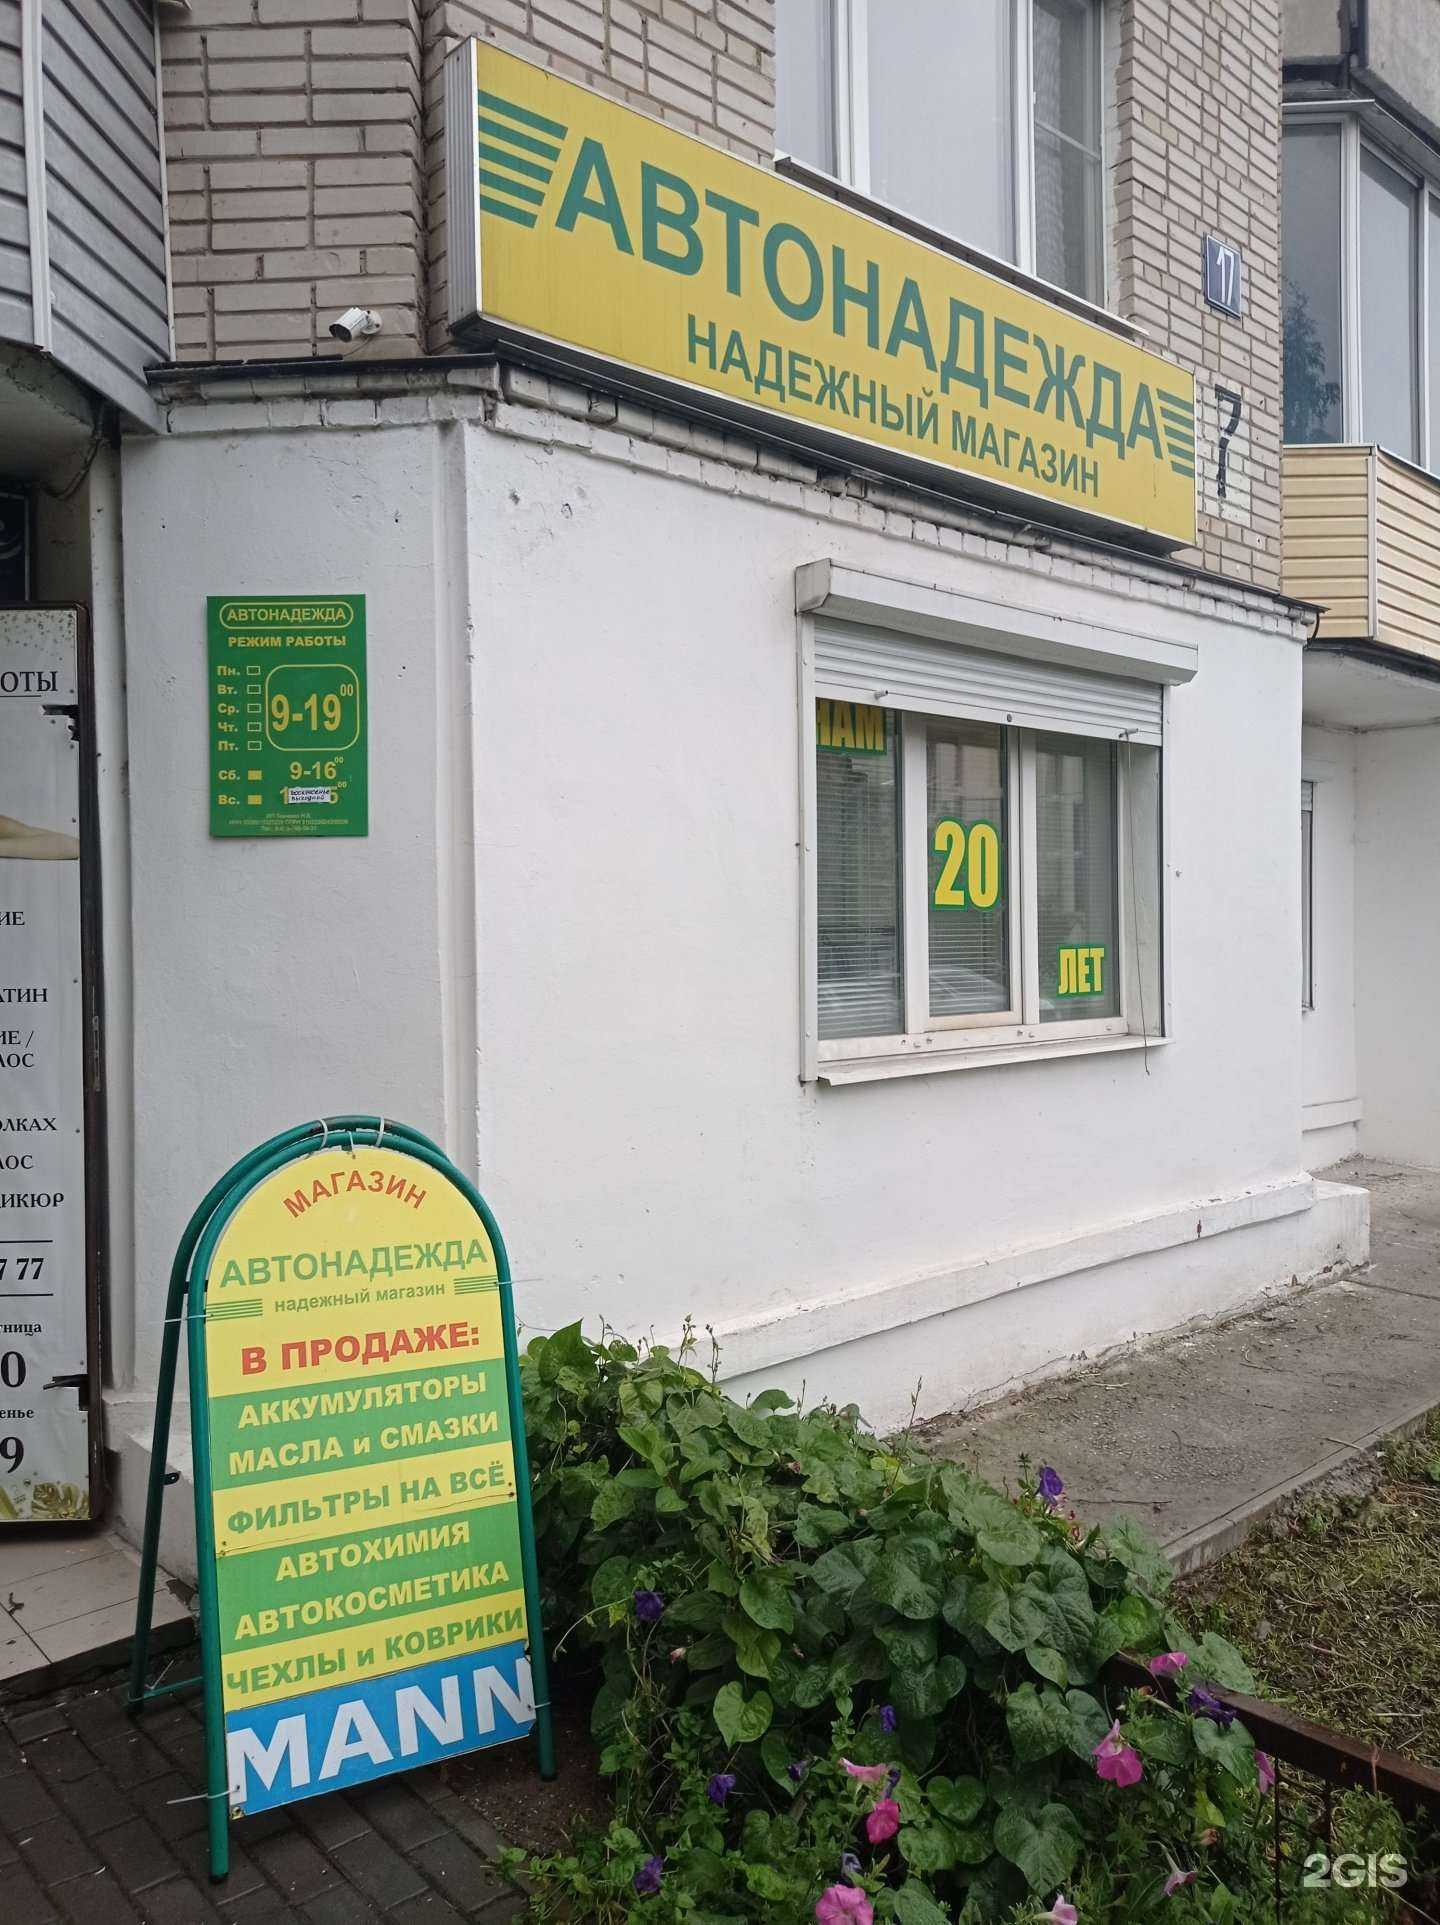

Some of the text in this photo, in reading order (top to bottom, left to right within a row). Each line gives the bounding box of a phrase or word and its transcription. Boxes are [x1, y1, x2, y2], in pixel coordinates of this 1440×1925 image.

[1216, 245, 1235, 306] 17
[556, 137, 1163, 461] АВТОНАДЕЖДА
[687, 314, 1099, 498] НАДЕЖНЫЙ МАГАЗИН
[227, 607, 346, 623] АВТОНАДЕЖДА
[228, 635, 346, 648] РЕЖИМ РАБОТЫ
[217, 665, 240, 677] Пн.
[217, 685, 237, 695] Вт.
[217, 703, 240, 716] Ср.
[217, 722, 238, 733] Чт.
[218, 741, 239, 751] Пт.
[218, 770, 240, 781] Сб.
[218, 795, 240, 805] Вс.
[933, 819, 1001, 909] 20
[1058, 946, 1105, 995] ЛЕТ
[0, 988, 48, 1002] ТИН
[0, 1117, 57, 1131] ЛКАХ
[0, 1193, 64, 1208] ИКЮР
[283, 1170, 427, 1218] МАГАЗИН
[16, 1258, 44, 1280] 77
[219, 1239, 488, 1288] АВТОНАДЕЖДА
[275, 1284, 445, 1313] надежный магазин
[0, 1323, 41, 1336] ница
[241, 1321, 480, 1376] В ПРОДАЖЕ:
[238, 1372, 487, 1429] АККУМУЛЯТОРЫ
[229, 1411, 498, 1476] МАСЛА и СМАЗКИ
[228, 1461, 505, 1534] ФИЛЬТРЫ НА ВСЁ
[276, 1521, 470, 1581] АВТОХИМИЯ
[235, 1561, 510, 1640] АВТОКОСМЕТИКА
[227, 1608, 524, 1695] ЧЕХЛЫ и КОВРИКИ
[226, 1657, 536, 1806] MANN
